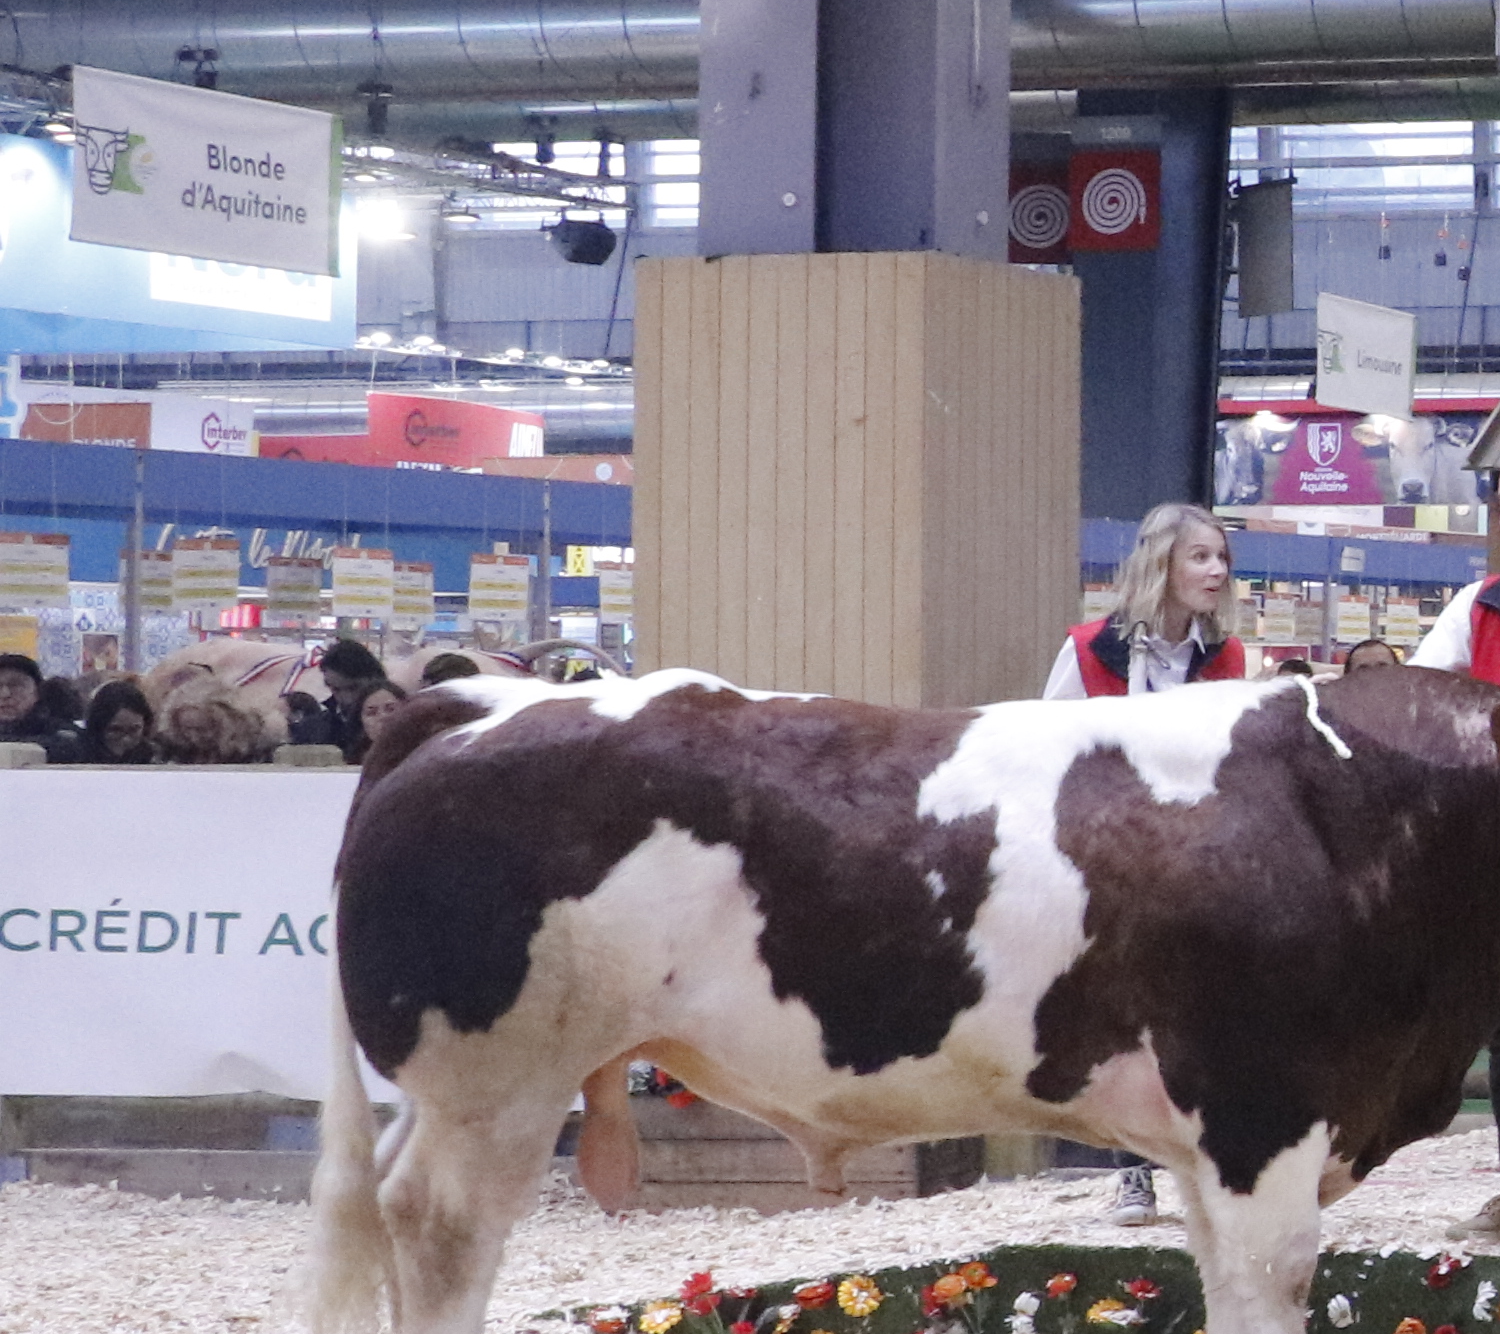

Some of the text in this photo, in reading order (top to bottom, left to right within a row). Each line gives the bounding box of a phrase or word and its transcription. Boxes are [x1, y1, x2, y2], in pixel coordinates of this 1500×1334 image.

[207, 143, 286, 181] Blonde
[181, 181, 307, 224] d'Aquitaine
[1299, 470, 1349, 483] Nouvelle-
[1299, 481, 1349, 495] Aquitaine
[0, 898, 242, 955] CRÉDIT
